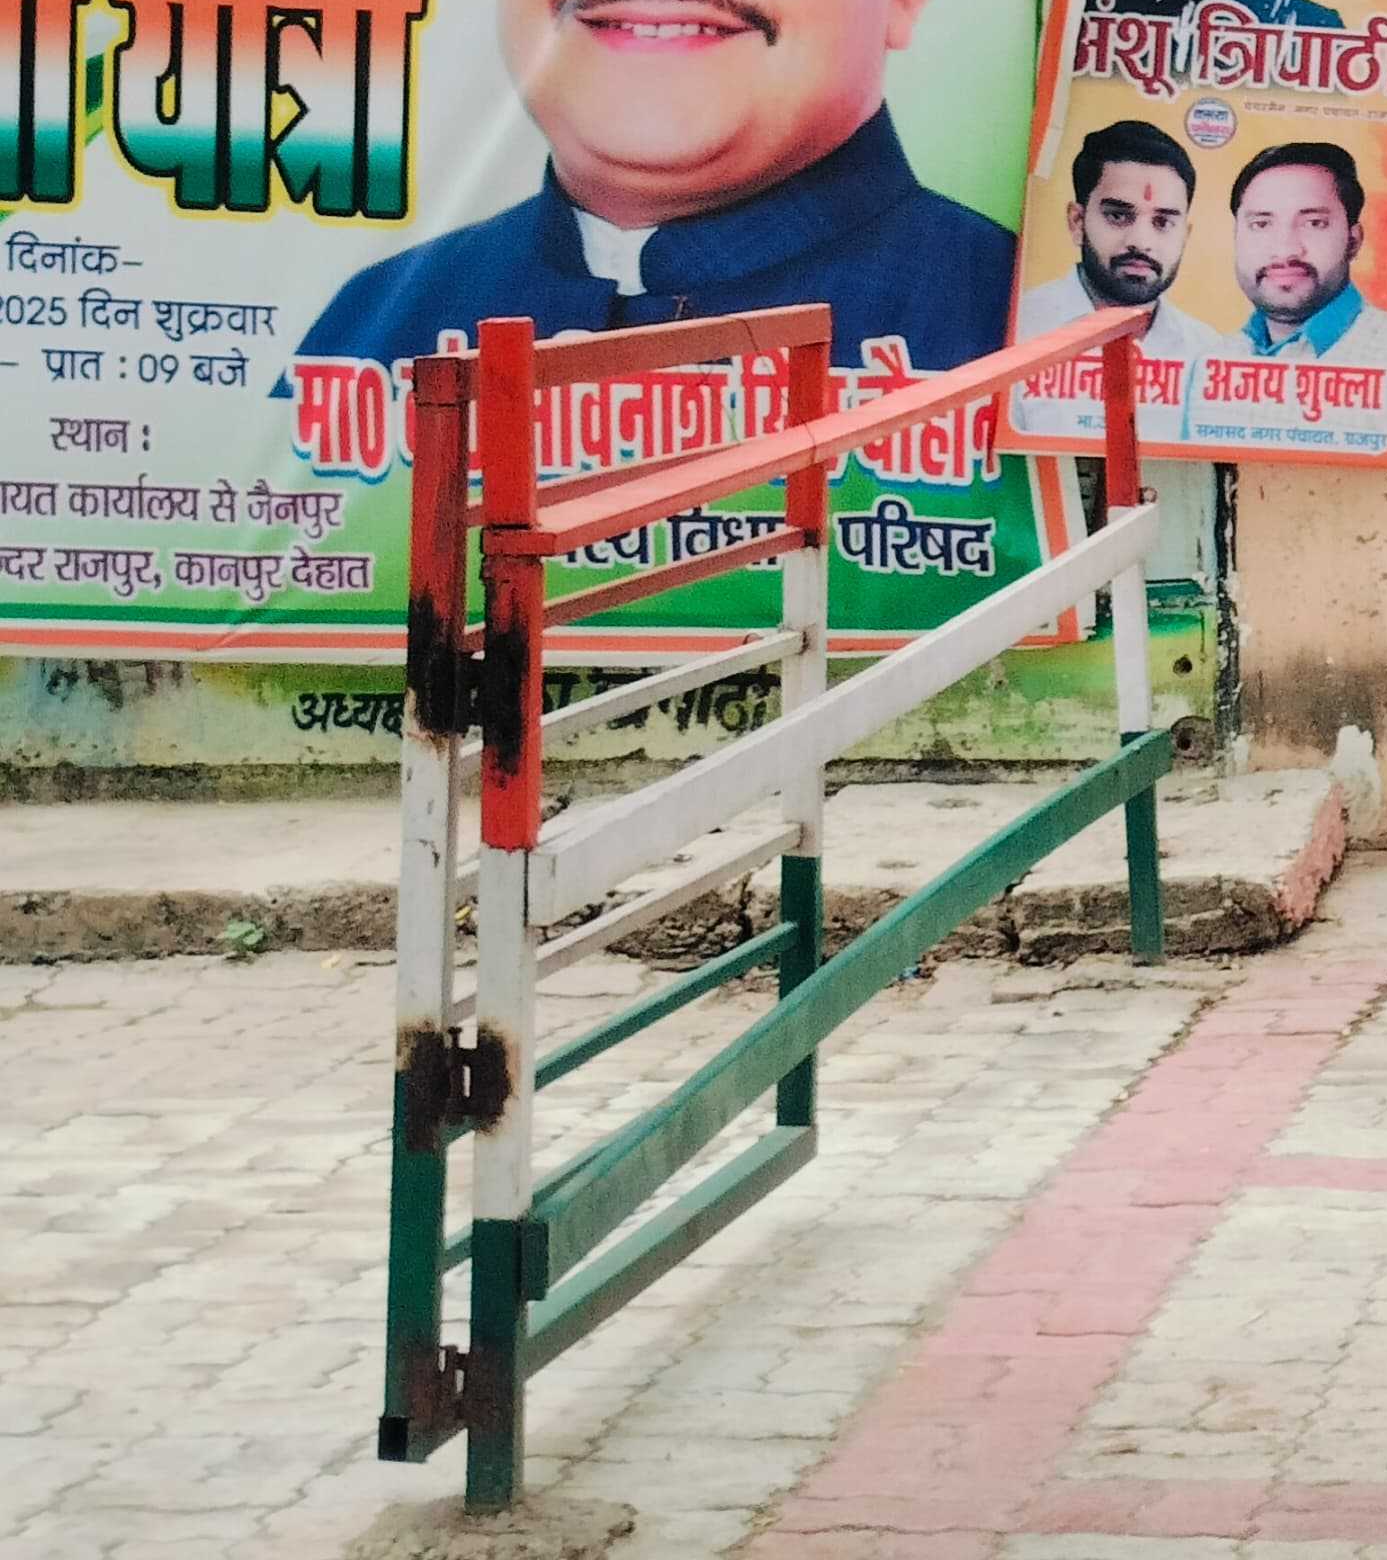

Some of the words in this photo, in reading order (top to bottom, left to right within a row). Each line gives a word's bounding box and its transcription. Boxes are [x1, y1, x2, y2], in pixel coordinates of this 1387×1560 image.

[0, 294, 67, 326] 025
[78, 287, 142, 330] दिन
[153, 297, 278, 342] शुक्रवार
[190, 347, 250, 387] बजे
[1203, 358, 1289, 403] अजय
[1295, 362, 1386, 421] शुक्ला
[68, 472, 200, 521] कार्यालय
[210, 477, 238, 524] से
[247, 478, 344, 539] जैनपुर
[837, 500, 993, 573] परिषद
[174, 552, 285, 600] कानपुर
[290, 545, 372, 590] देहात
